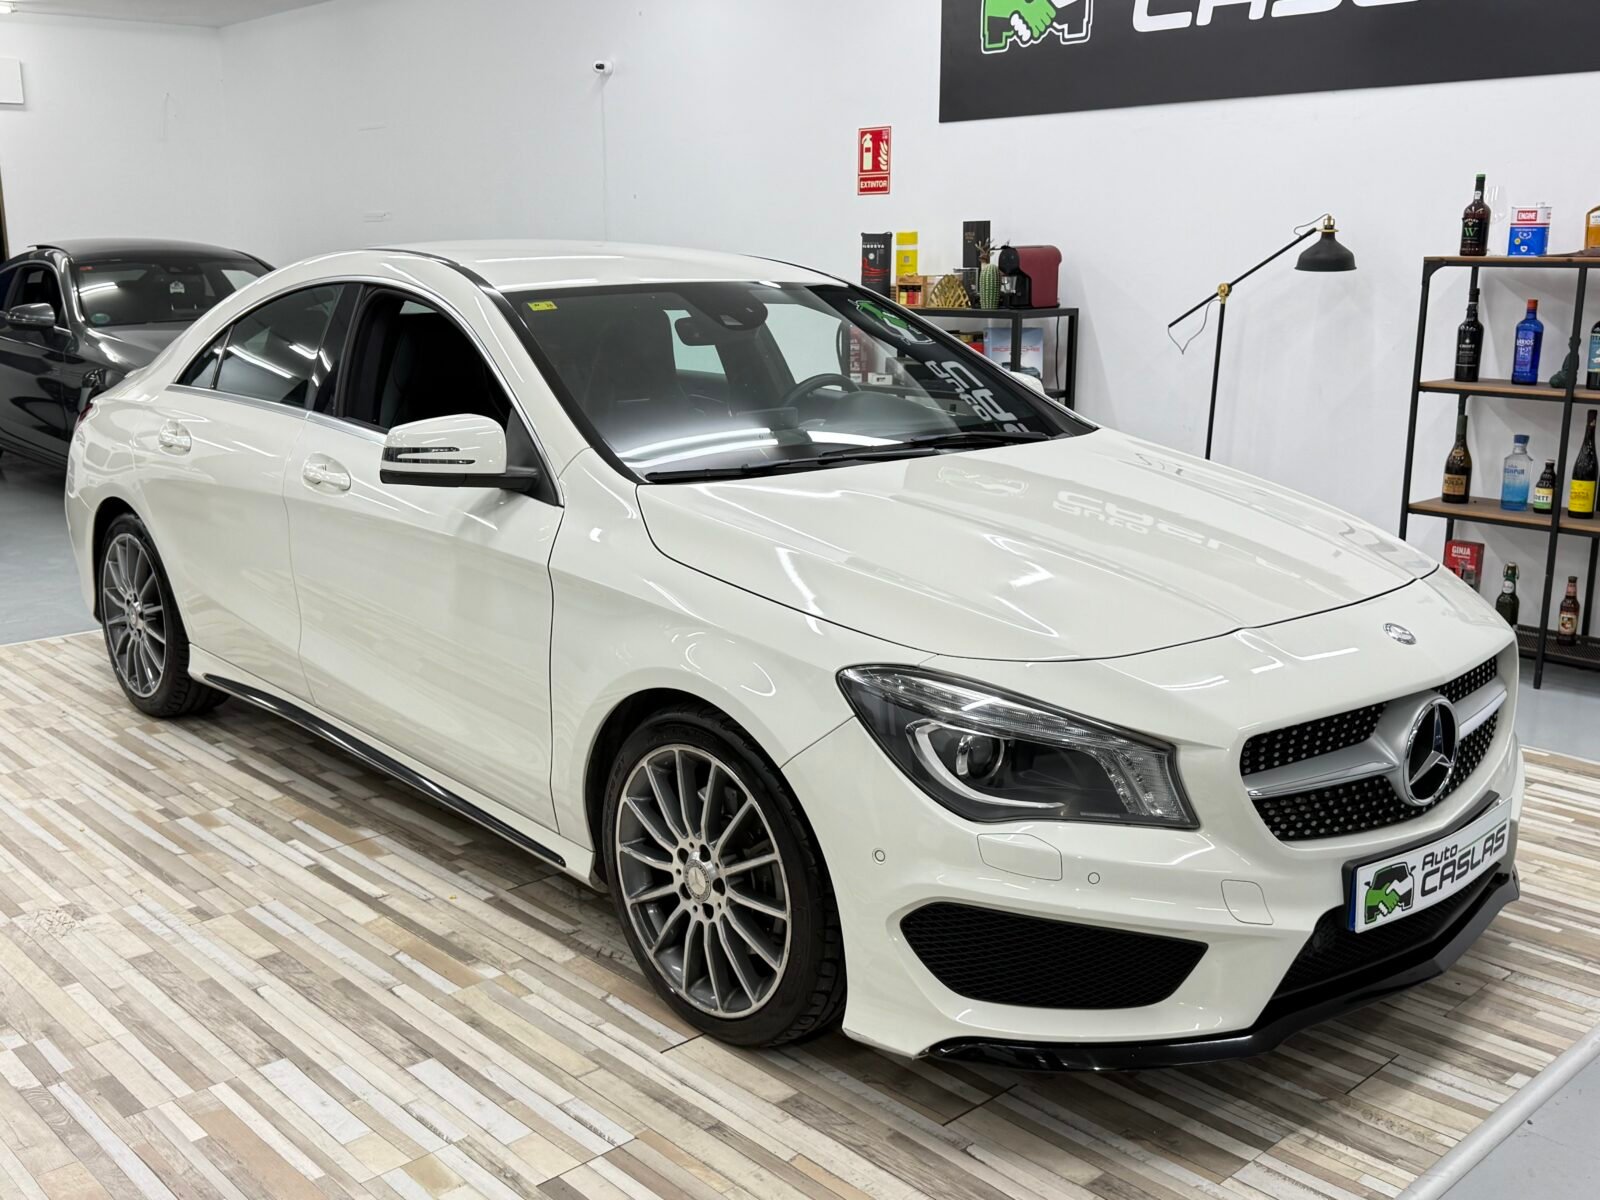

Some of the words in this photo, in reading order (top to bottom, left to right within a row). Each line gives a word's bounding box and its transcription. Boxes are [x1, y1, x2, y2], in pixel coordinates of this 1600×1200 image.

[860, 180, 888, 189] EXTINTOR
[1518, 211, 1537, 220] ENGINE
[1421, 843, 1459, 871] Auto
[1421, 824, 1506, 897] CASLAS
